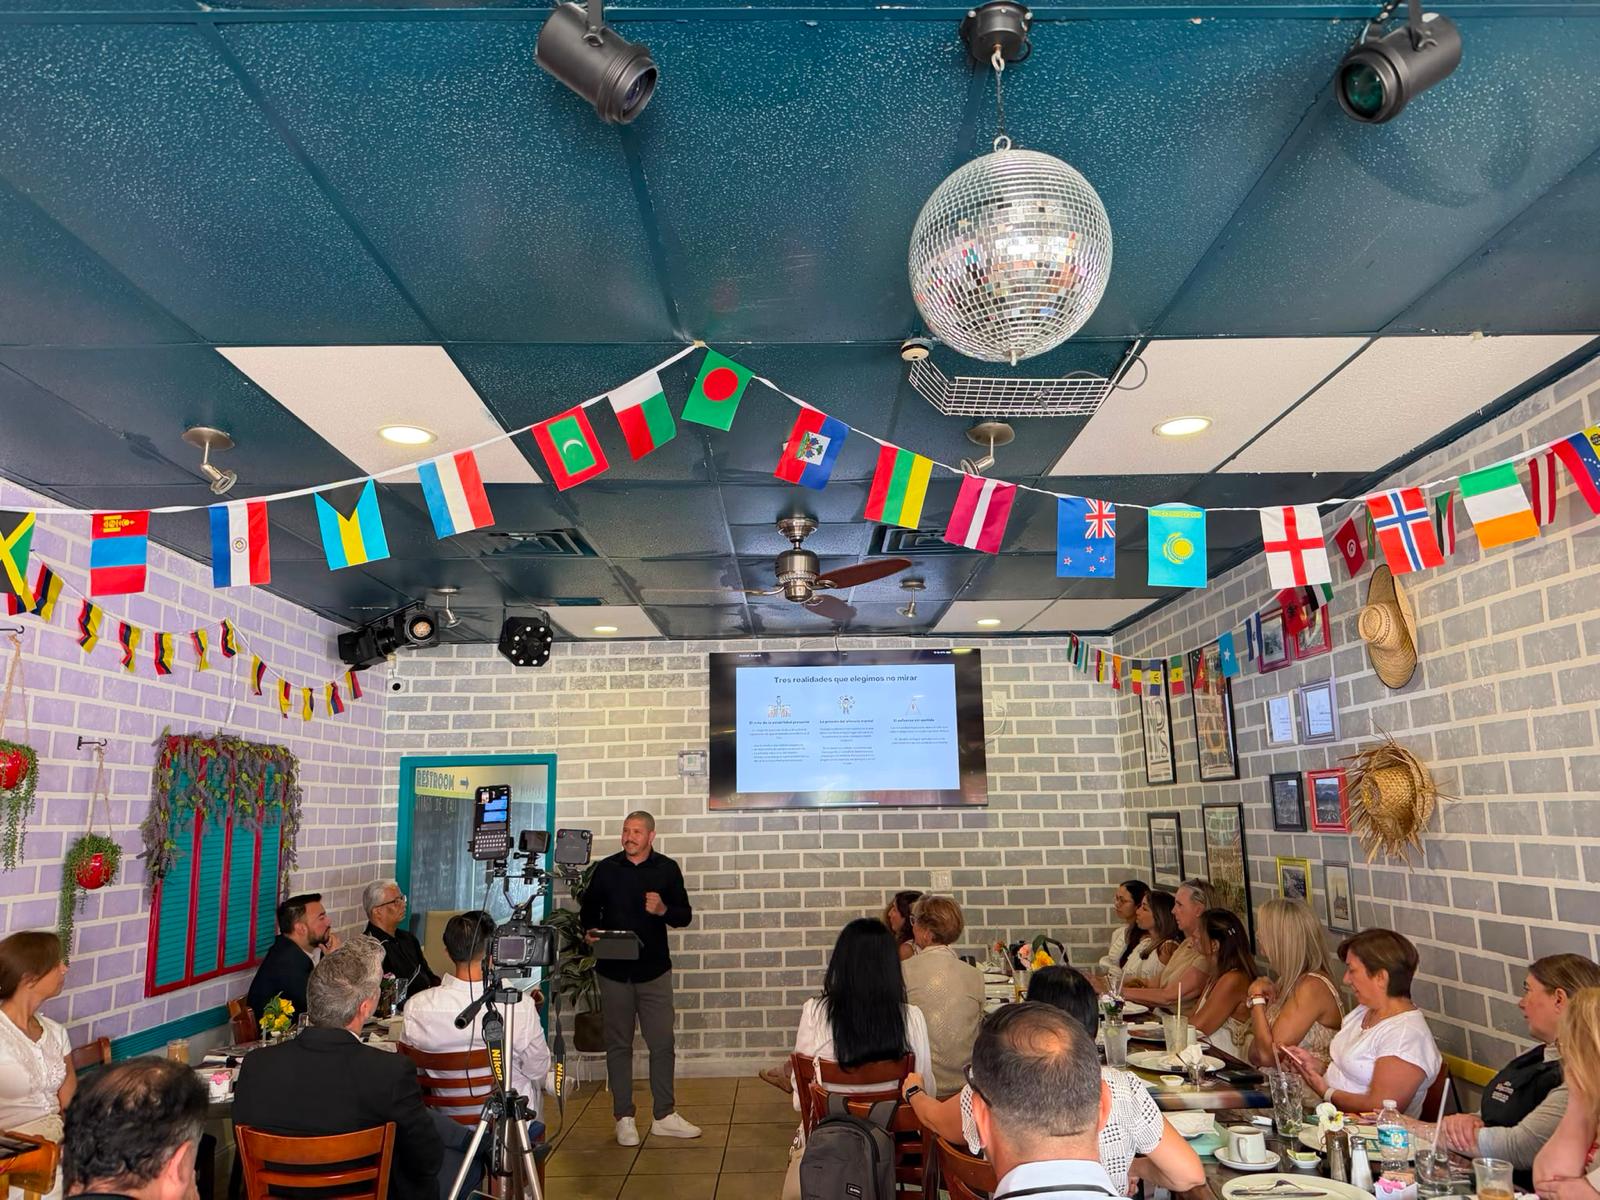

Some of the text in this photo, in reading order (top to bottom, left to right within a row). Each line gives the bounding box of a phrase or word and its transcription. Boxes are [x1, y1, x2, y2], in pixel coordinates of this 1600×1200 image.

[834, 676, 849, 685] que
[850, 675, 885, 683] elegimos
[416, 769, 455, 790] RESTROOM
[492, 1049, 503, 1081] Nikon
